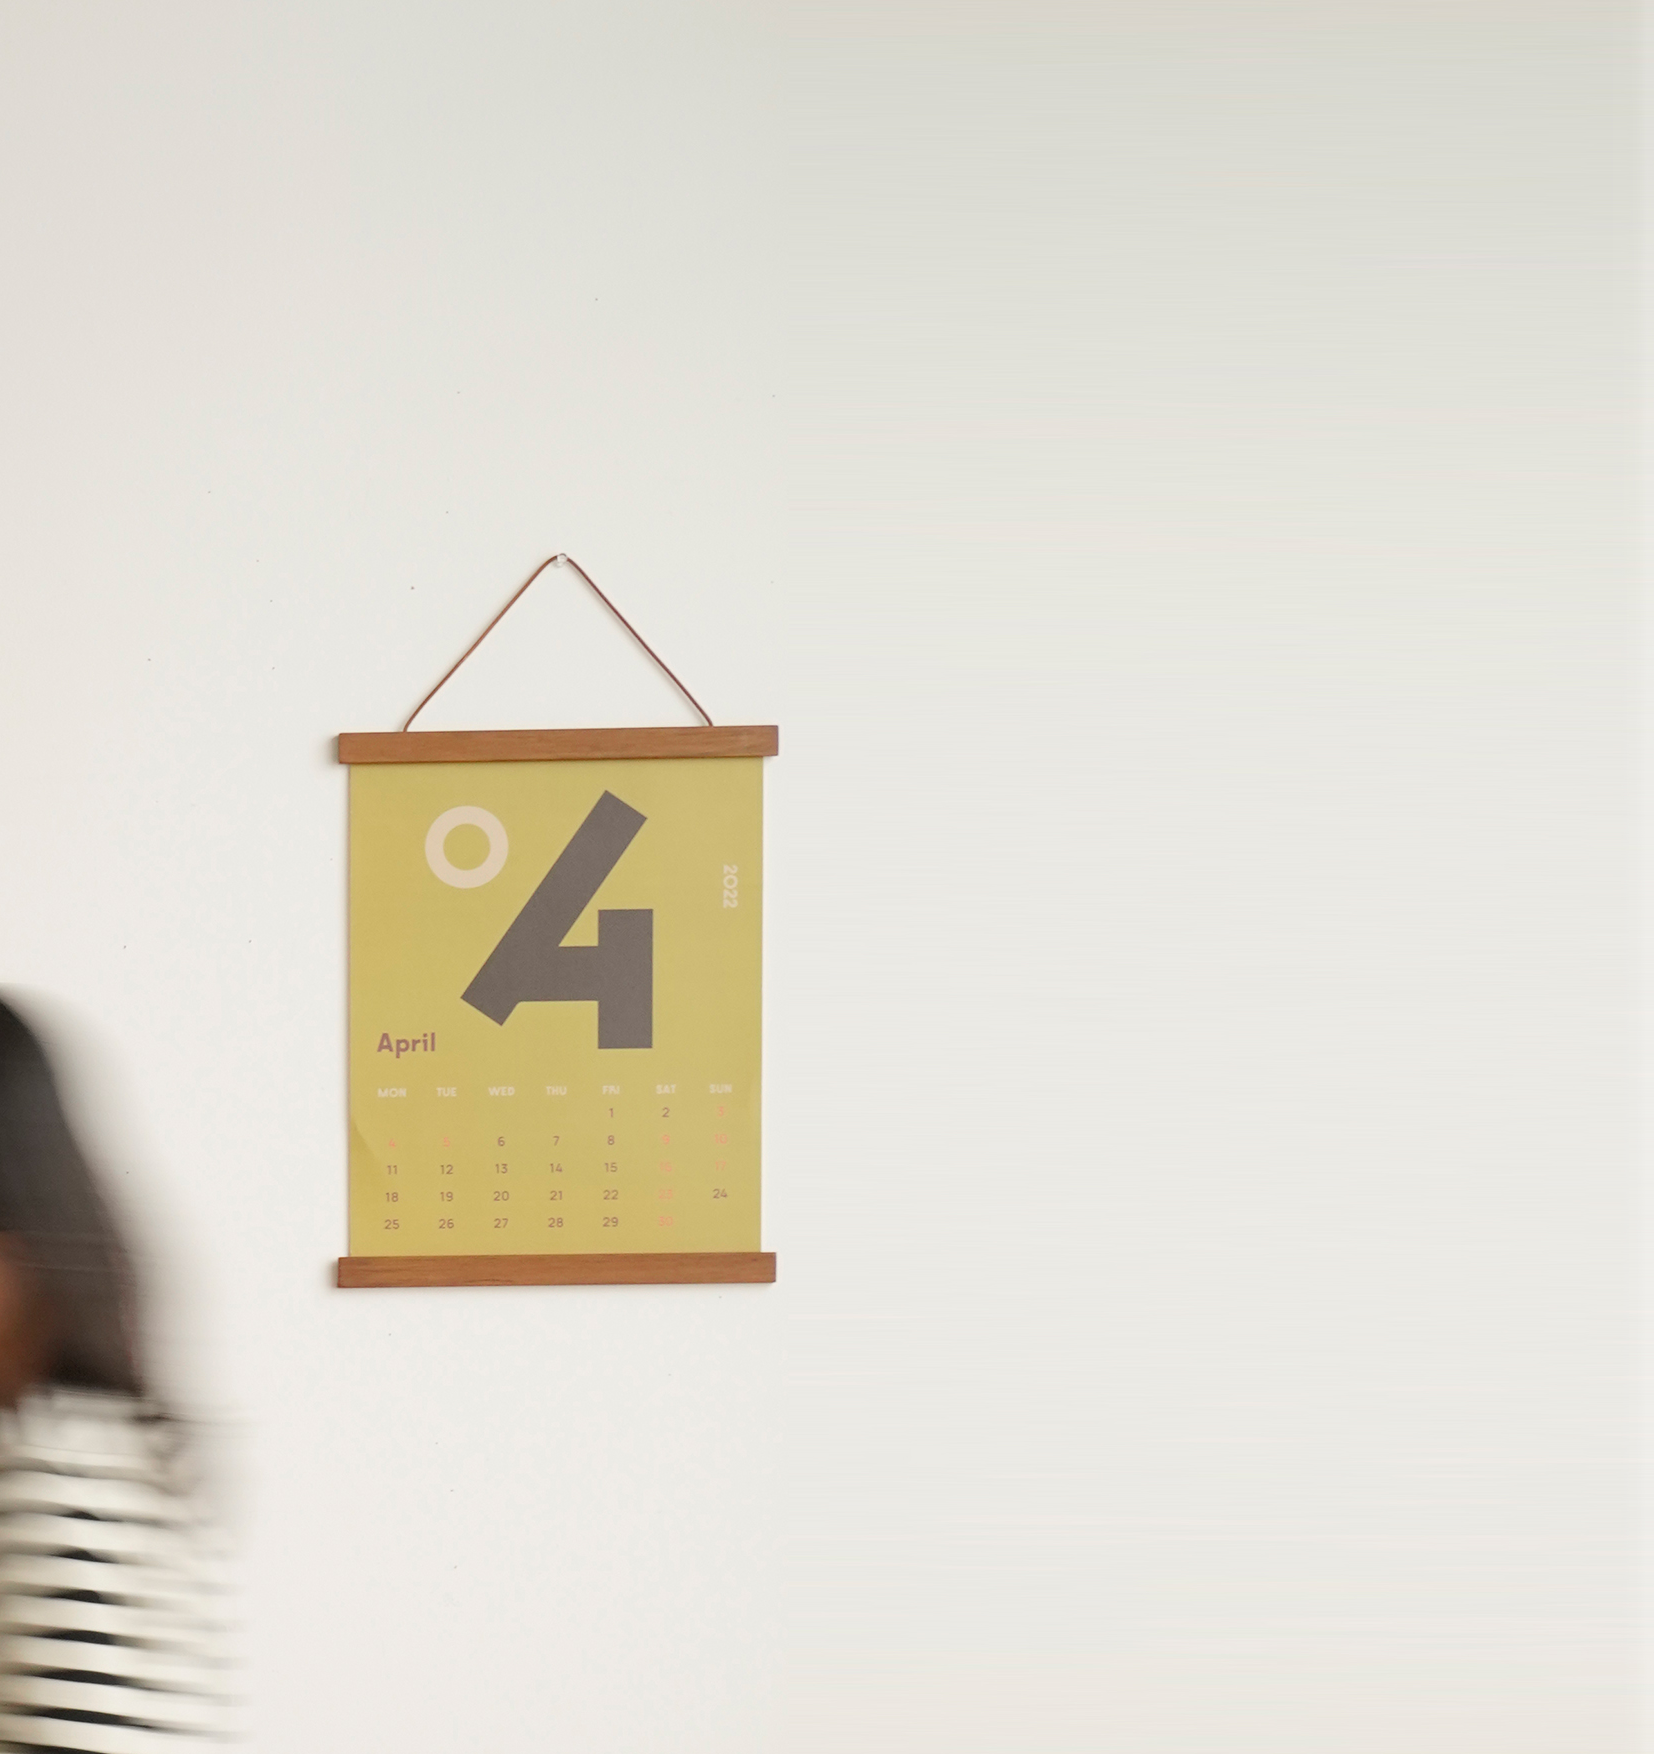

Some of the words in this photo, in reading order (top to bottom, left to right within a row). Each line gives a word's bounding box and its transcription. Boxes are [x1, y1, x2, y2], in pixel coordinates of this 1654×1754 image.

[722, 864, 739, 909] 2022
[377, 1031, 436, 1059] April
[377, 1088, 407, 1098] MON
[436, 1087, 457, 1097] TUE
[488, 1086, 515, 1097] WED
[545, 1086, 567, 1096] THU
[602, 1085, 620, 1095] FRI
[655, 1084, 677, 1095] SAT
[709, 1084, 732, 1094] SUN
[608, 1107, 615, 1118] 1
[662, 1107, 670, 1118] 2
[717, 1106, 724, 1117] 3
[388, 1138, 396, 1148] 4
[443, 1137, 451, 1148] 5
[497, 1136, 506, 1147] 6
[553, 1135, 560, 1146] 7
[607, 1135, 615, 1146] 8
[662, 1134, 670, 1145] 9
[714, 1133, 728, 1145] 10
[386, 1165, 398, 1175] 11
[439, 1164, 454, 1175] 12
[495, 1163, 508, 1174] 13
[549, 1163, 563, 1174] 14
[604, 1162, 618, 1173] 15
[659, 1161, 672, 1172] 16
[714, 1161, 727, 1172] 17
[385, 1192, 399, 1203] 18
[439, 1191, 454, 1202] 19
[493, 1190, 510, 1202] 20
[549, 1190, 564, 1201] 21
[603, 1189, 619, 1201] 22
[658, 1189, 674, 1200] 23
[712, 1188, 728, 1199] 24
[383, 1219, 400, 1230] 25
[438, 1219, 455, 1230] 26
[493, 1218, 509, 1229] 27
[547, 1217, 564, 1228] 28
[602, 1216, 619, 1228] 29
[658, 1216, 674, 1227] 30
